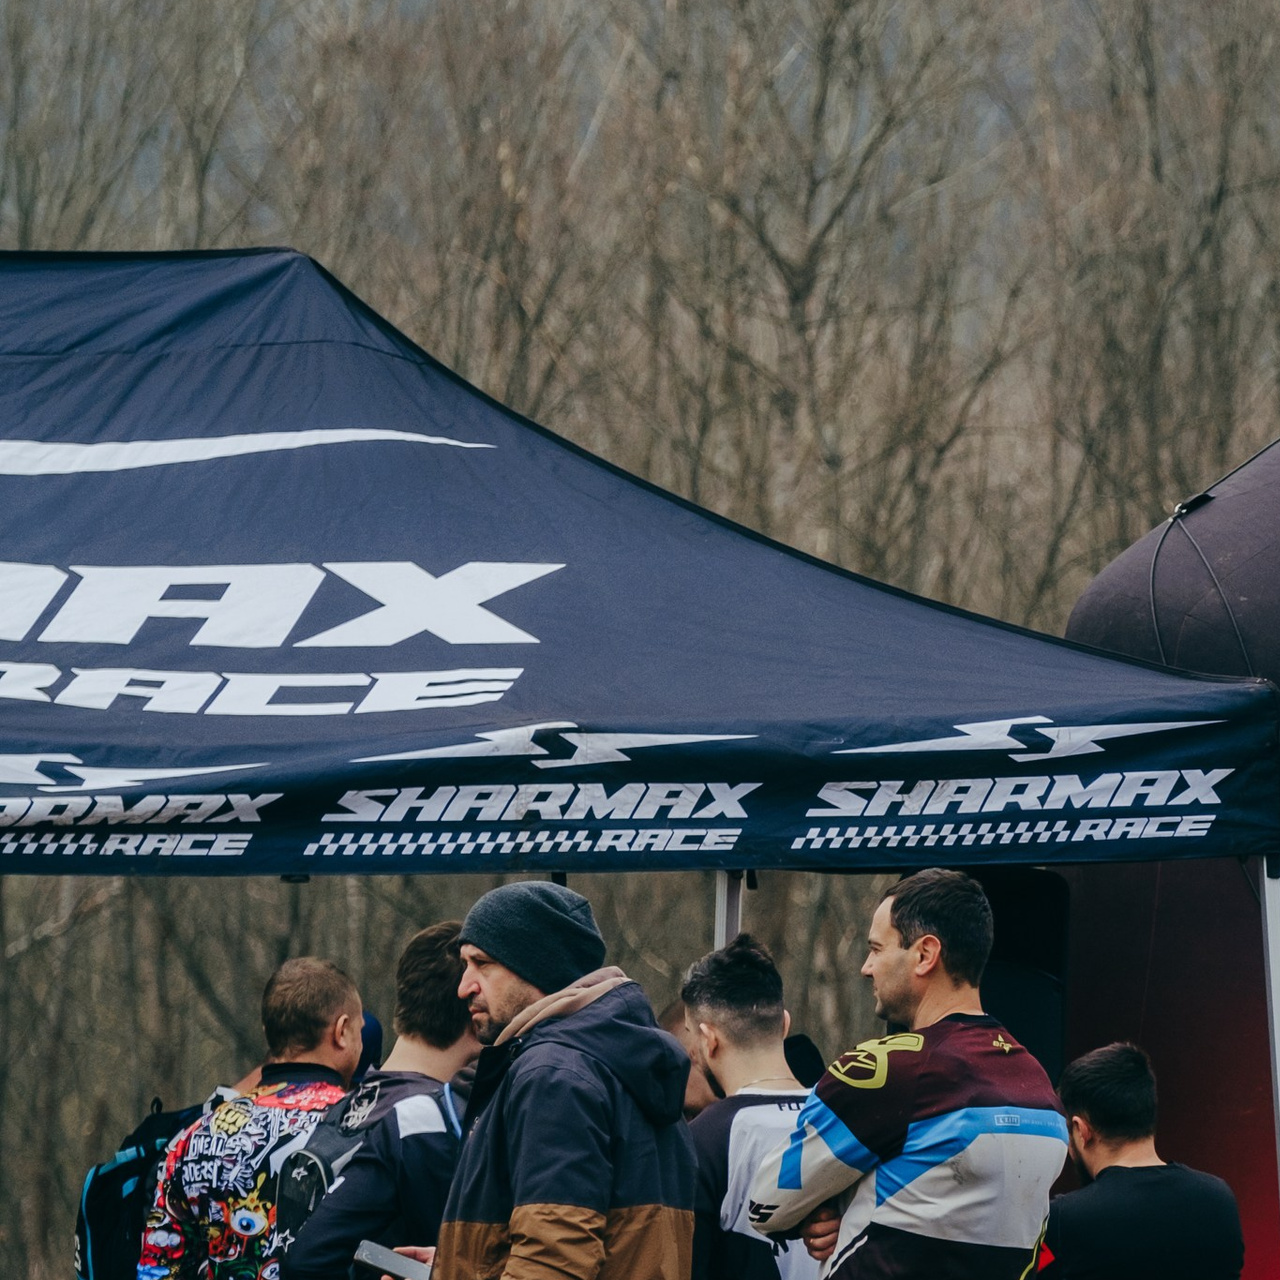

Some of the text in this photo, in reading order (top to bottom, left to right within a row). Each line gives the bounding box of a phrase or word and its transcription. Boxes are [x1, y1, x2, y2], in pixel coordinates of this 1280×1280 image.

[321, 782, 764, 822] SHARMAX
[805, 768, 1236, 818] SHARMAX
[597, 828, 742, 852] RACE
[1072, 815, 1216, 842] RACE
[100, 833, 253, 856] RACE
[777, 1100, 802, 1112] FO
